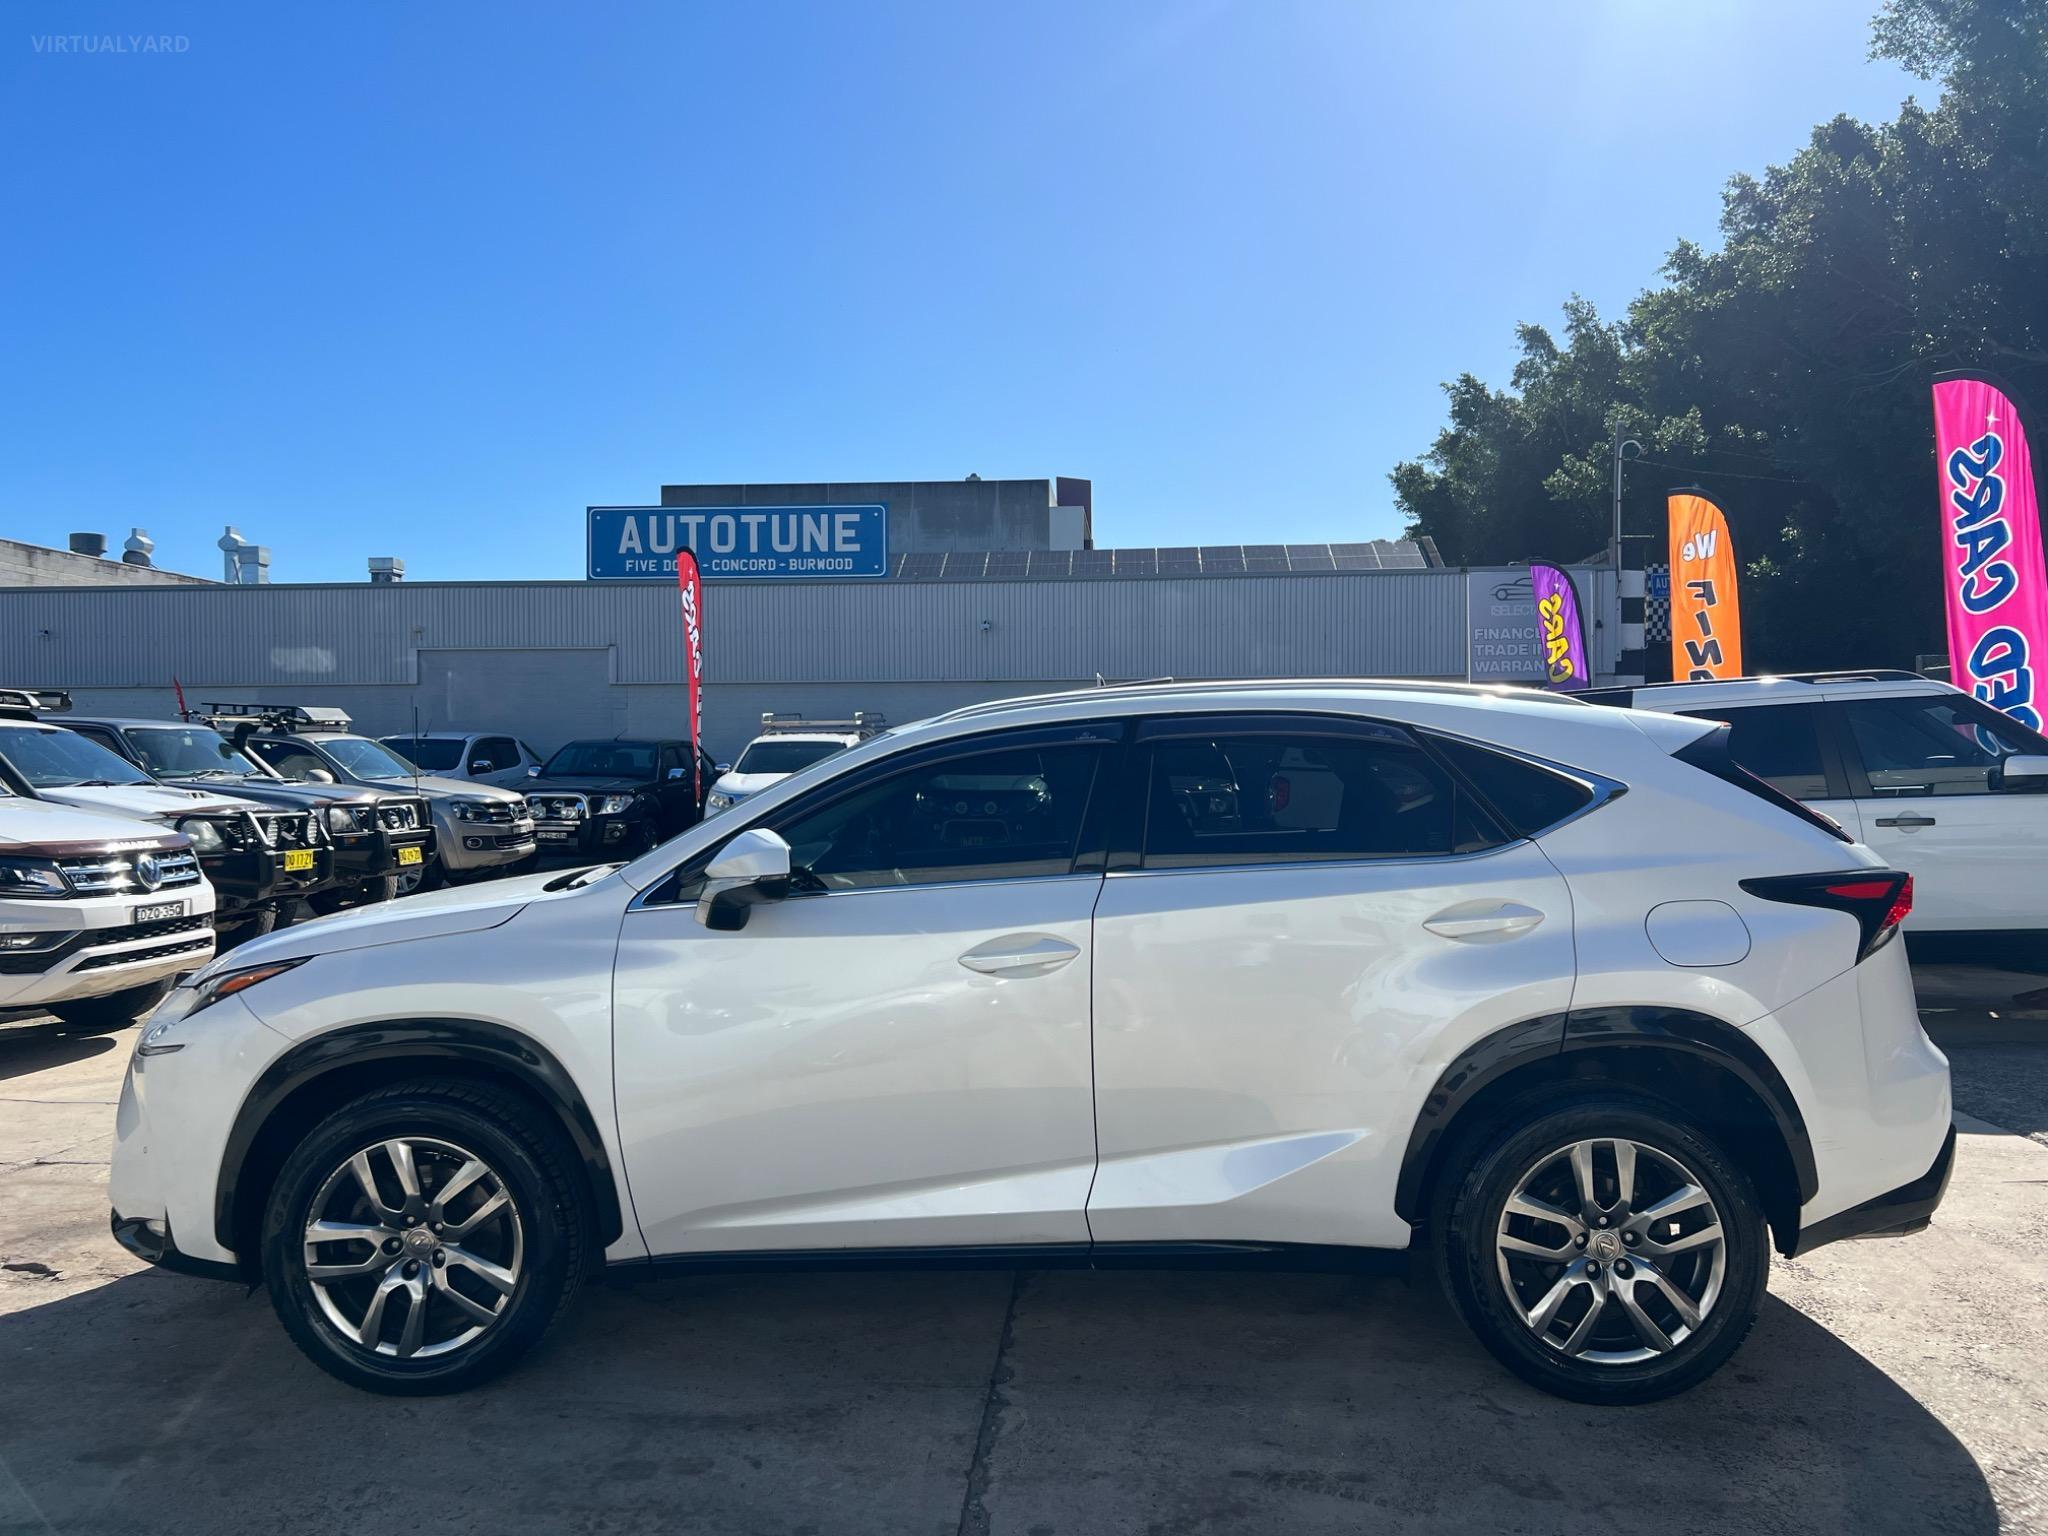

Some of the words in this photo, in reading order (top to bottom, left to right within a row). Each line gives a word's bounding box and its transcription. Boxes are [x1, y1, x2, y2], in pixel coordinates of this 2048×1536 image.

[618, 513, 861, 554] AUTOTUNE
[625, 559, 657, 572] FIVE
[1474, 643, 1529, 656] TRADE
[1474, 660, 1546, 673] WARRAN
